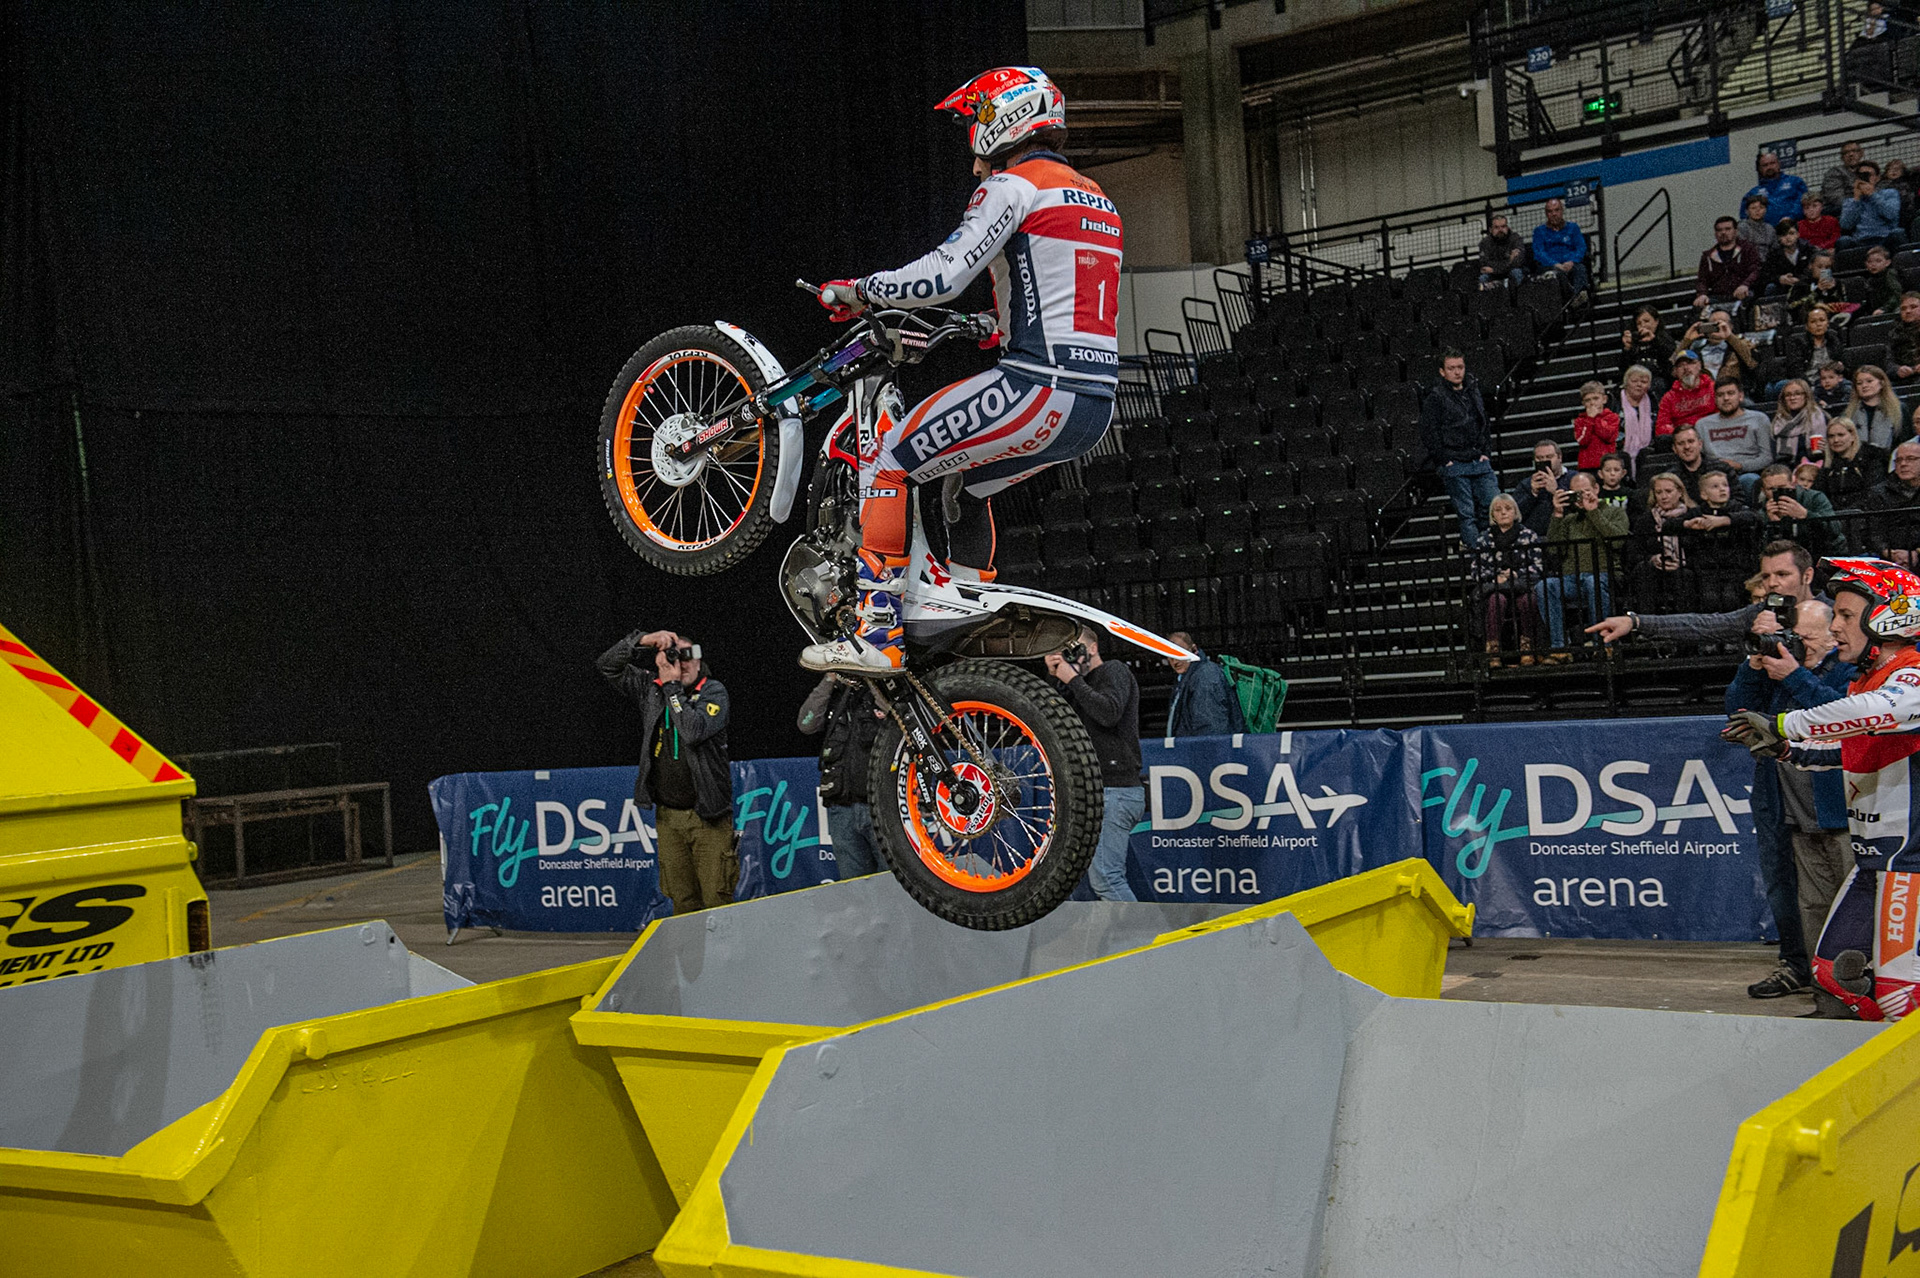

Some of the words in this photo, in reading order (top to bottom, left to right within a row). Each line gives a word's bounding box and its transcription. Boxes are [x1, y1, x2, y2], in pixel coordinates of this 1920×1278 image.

[1528, 51, 1549, 63] 220
[1012, 85, 1037, 97] SPEA
[979, 101, 1034, 154] hebo
[1567, 185, 1587, 197] 120
[964, 204, 1014, 269] hebo
[1081, 217, 1121, 237] hebo
[1250, 244, 1268, 254] 120
[868, 273, 952, 300] REPSOL
[1017, 252, 1038, 326] HONDA
[1098, 280, 1106, 321] 1
[901, 337, 928, 348] RENTHAL
[1069, 347, 1119, 366] HONDA
[699, 416, 729, 444] SHOWA
[909, 377, 1022, 462] REPSOL
[918, 451, 970, 481] hebo
[1850, 567, 1876, 577] hebo
[923, 602, 972, 615] COTA
[1808, 713, 1896, 736] HONDA
[912, 727, 928, 748] NGK
[899, 761, 911, 824] REPSOL
[916, 772, 931, 804] GALFER
[1150, 763, 1317, 830] DSA
[736, 780, 812, 879] Fly
[1421, 758, 1520, 879] Fly
[1525, 759, 1739, 836] DSA
[470, 797, 534, 888] Fly
[535, 799, 655, 857] DSA
[1152, 836, 1215, 848] Doncaster
[1217, 835, 1268, 848] Sheffield
[1271, 835, 1318, 850] Airport
[1530, 842, 1605, 856] Doncaster
[1611, 841, 1679, 855] Sheffield
[1684, 841, 1740, 858] Airport
[538, 859, 582, 870] Doncaster
[584, 857, 622, 870] Sheffield
[623, 858, 654, 872] Airport
[1153, 867, 1260, 895] arena
[1533, 877, 1668, 907] arena
[541, 884, 618, 908] arena
[62, 942, 115, 965] LTD
